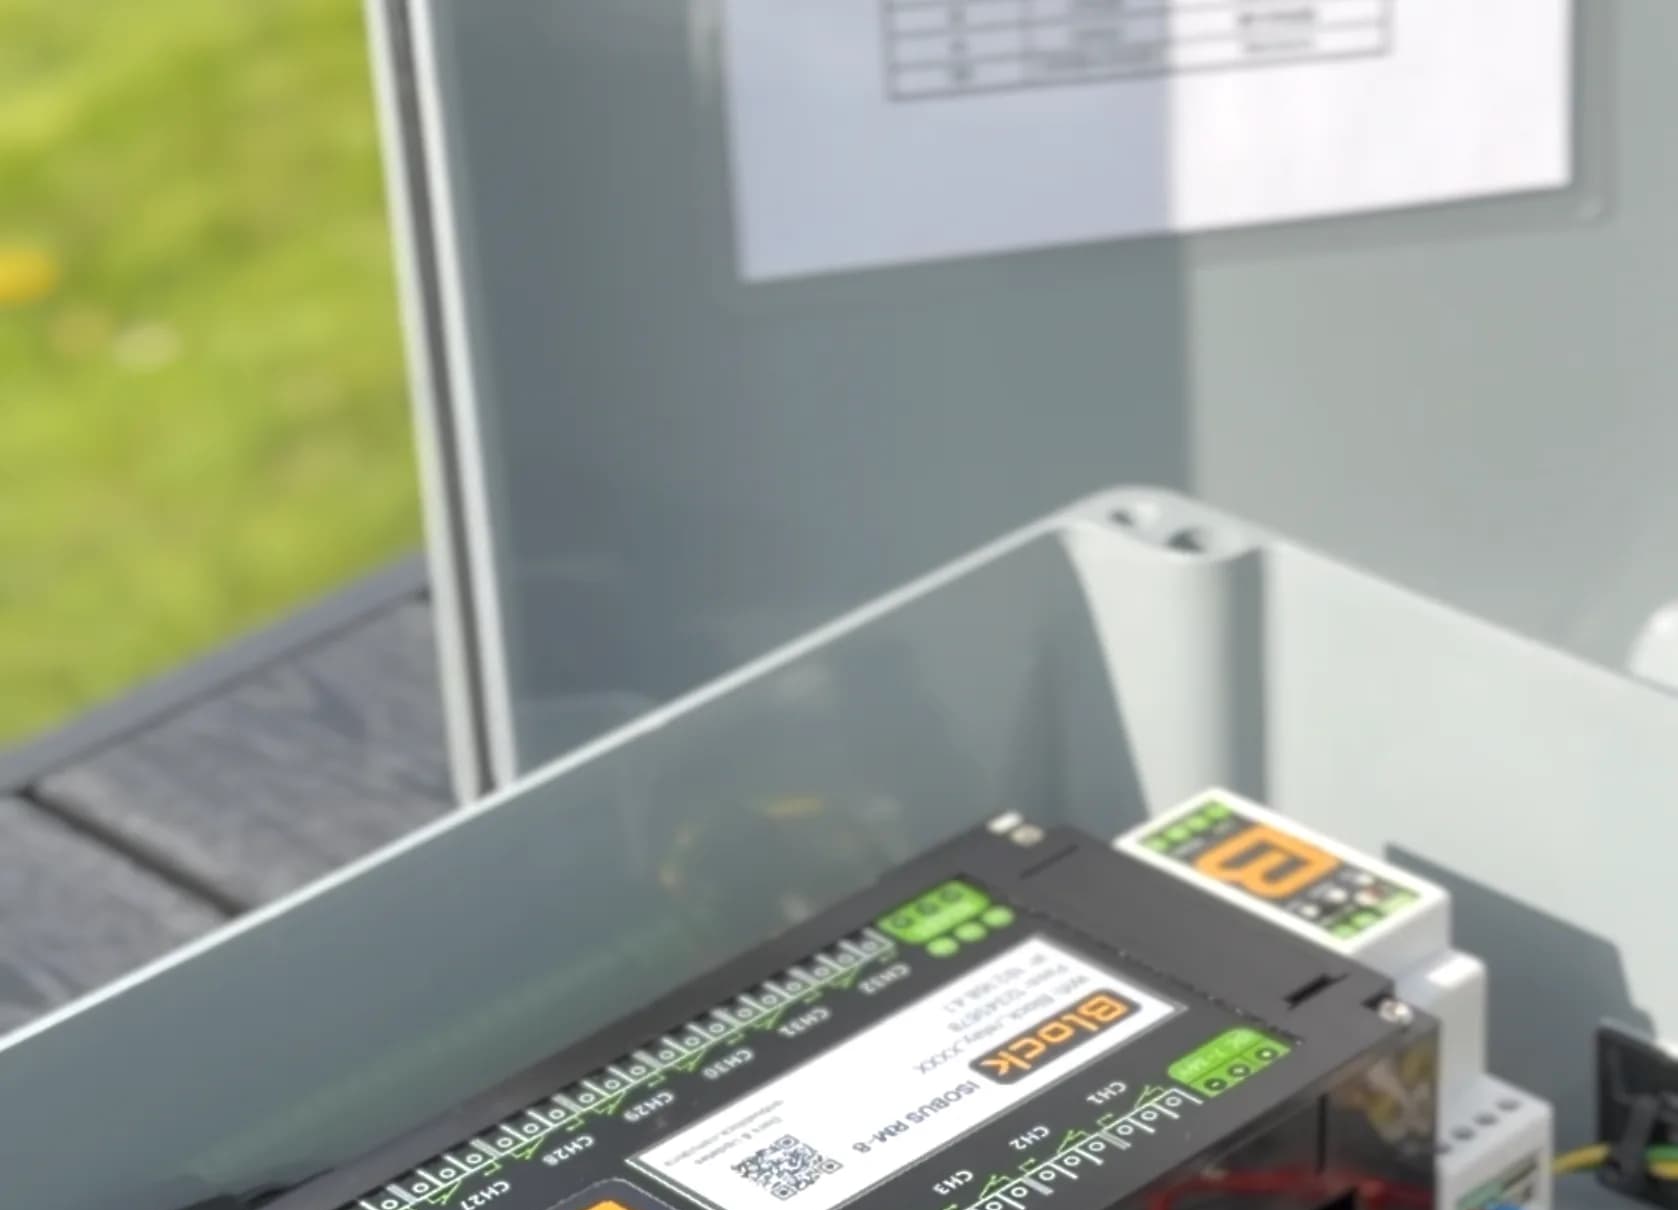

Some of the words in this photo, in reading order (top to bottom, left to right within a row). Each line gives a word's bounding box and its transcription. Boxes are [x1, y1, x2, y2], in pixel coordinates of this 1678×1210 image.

[773, 1005, 836, 1039] CH31
[980, 993, 1130, 1075] Block
[696, 1047, 758, 1080] CH30
[617, 1089, 679, 1123] CH29
[902, 1079, 982, 1124] ISOBUS
[1083, 1079, 1130, 1106] CH1
[537, 1134, 598, 1167] CH28
[1005, 1123, 1054, 1151] CH2
[929, 1168, 978, 1196] CH3
